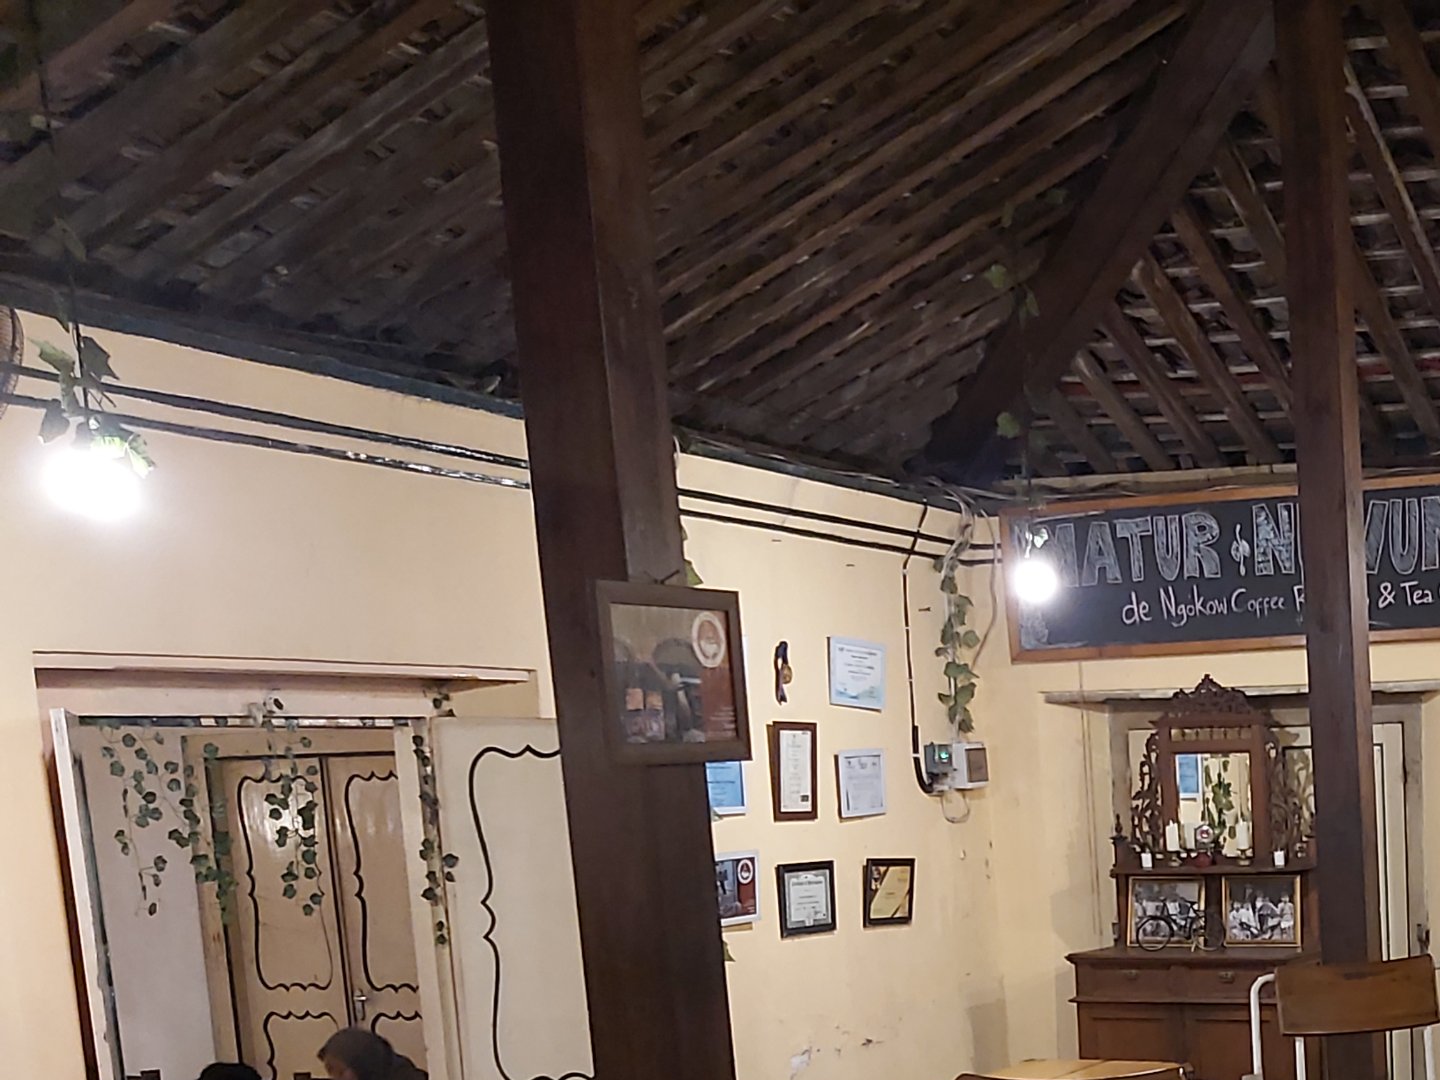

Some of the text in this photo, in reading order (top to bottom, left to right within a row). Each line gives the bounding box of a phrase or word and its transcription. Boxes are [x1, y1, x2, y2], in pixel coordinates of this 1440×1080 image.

[1122, 591, 1152, 624] de
[1159, 584, 1227, 627] Ngokow
[1231, 588, 1286, 618] Coffee
[1377, 581, 1395, 608] &
[1400, 580, 1433, 606] Tea
